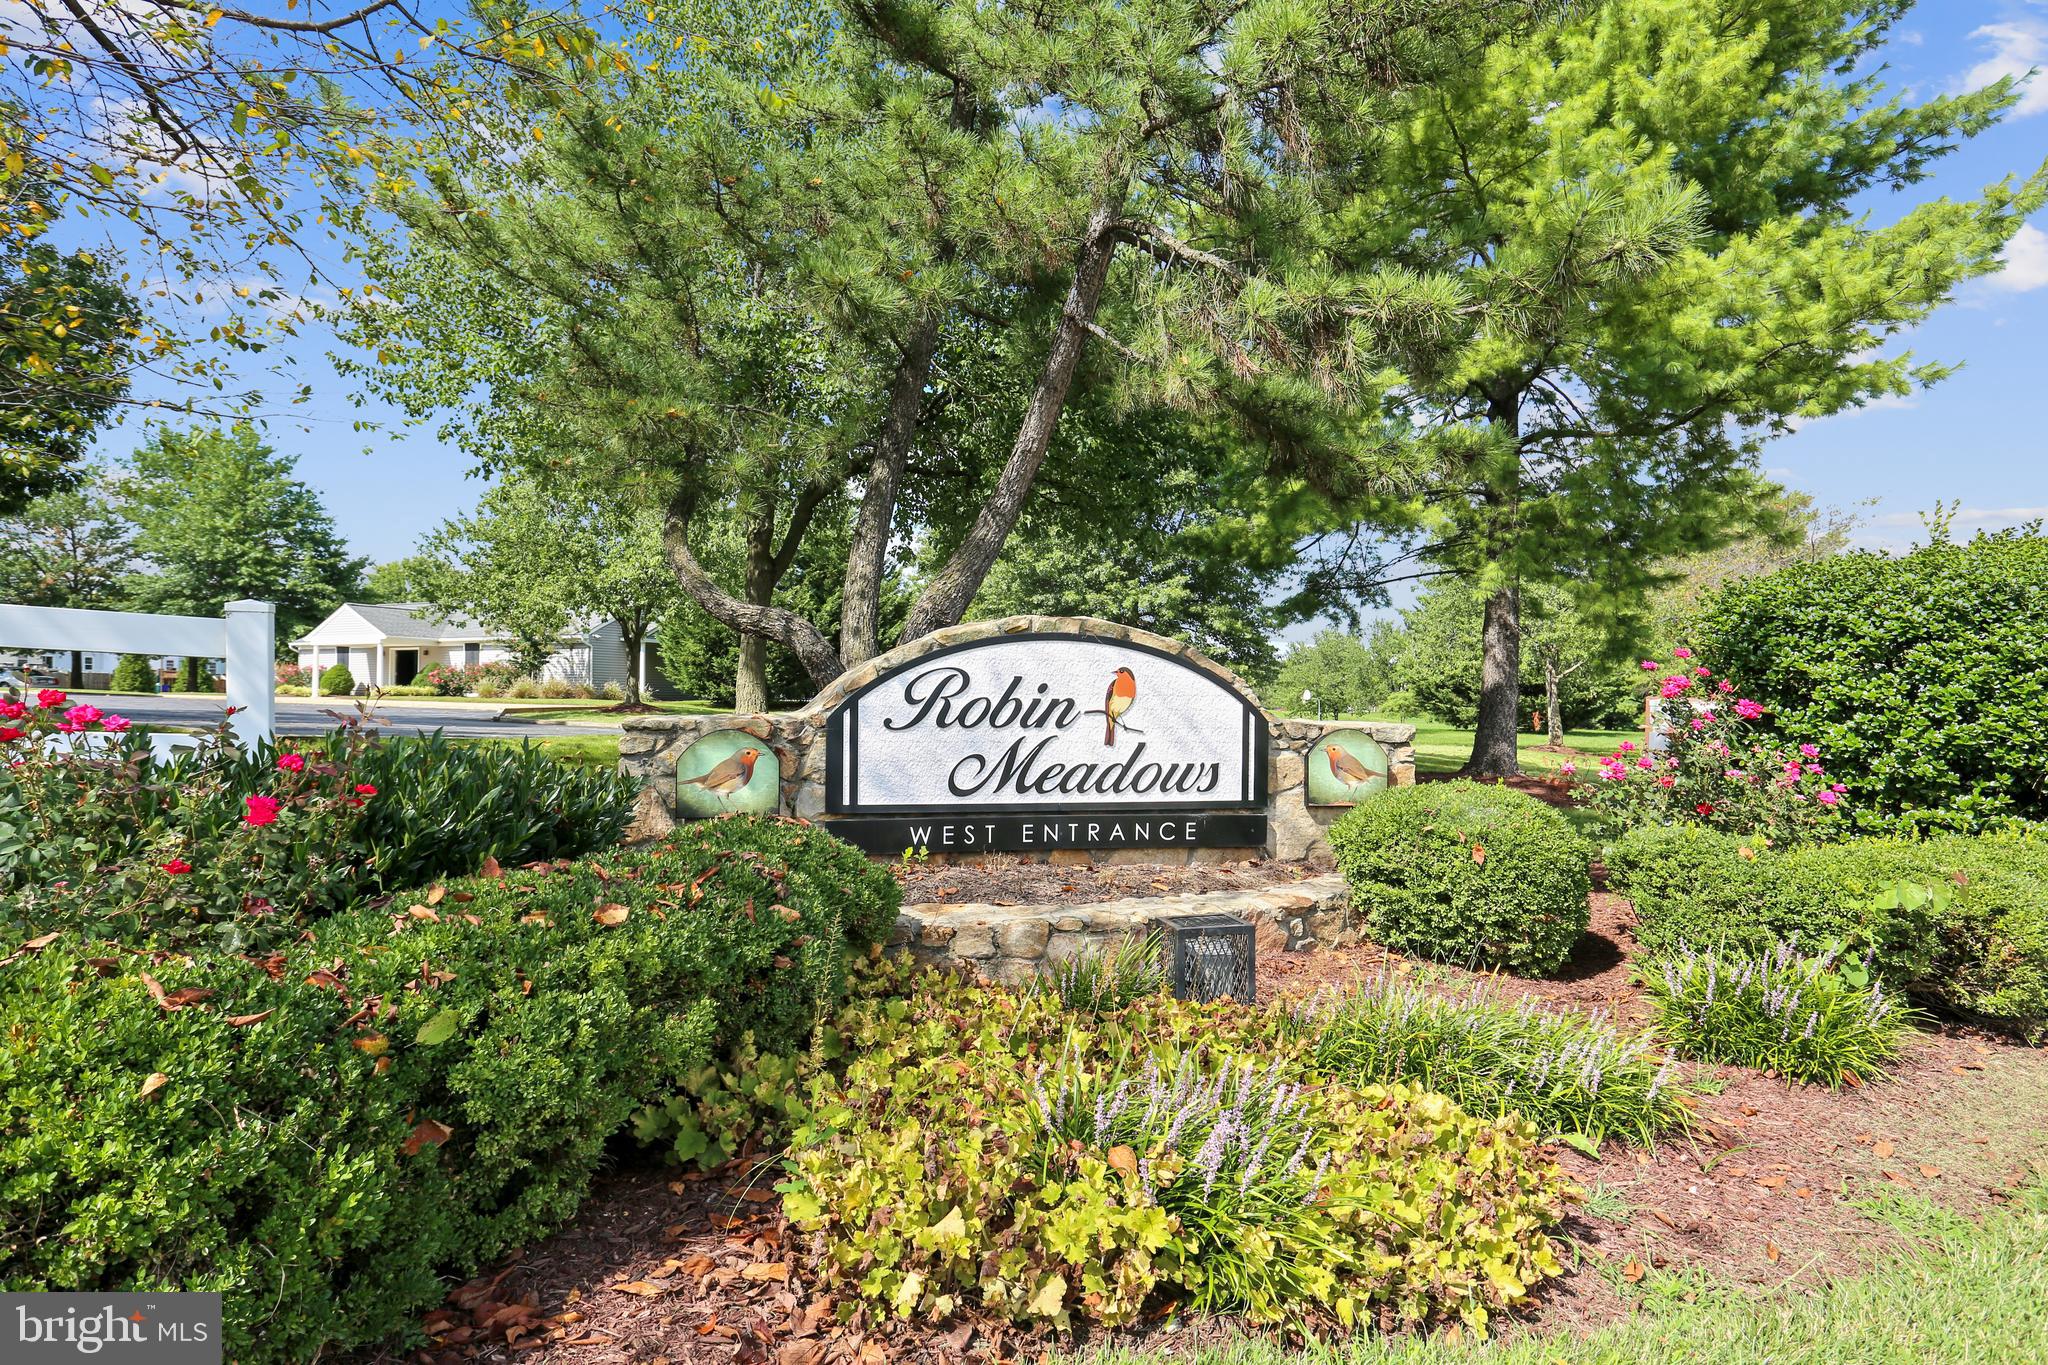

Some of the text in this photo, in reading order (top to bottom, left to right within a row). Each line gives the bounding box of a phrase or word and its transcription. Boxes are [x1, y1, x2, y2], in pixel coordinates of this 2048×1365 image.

[884, 666, 1080, 731] Robin
[948, 735, 1220, 797] Meadows
[909, 821, 1197, 846] WEST ENTRANCE
